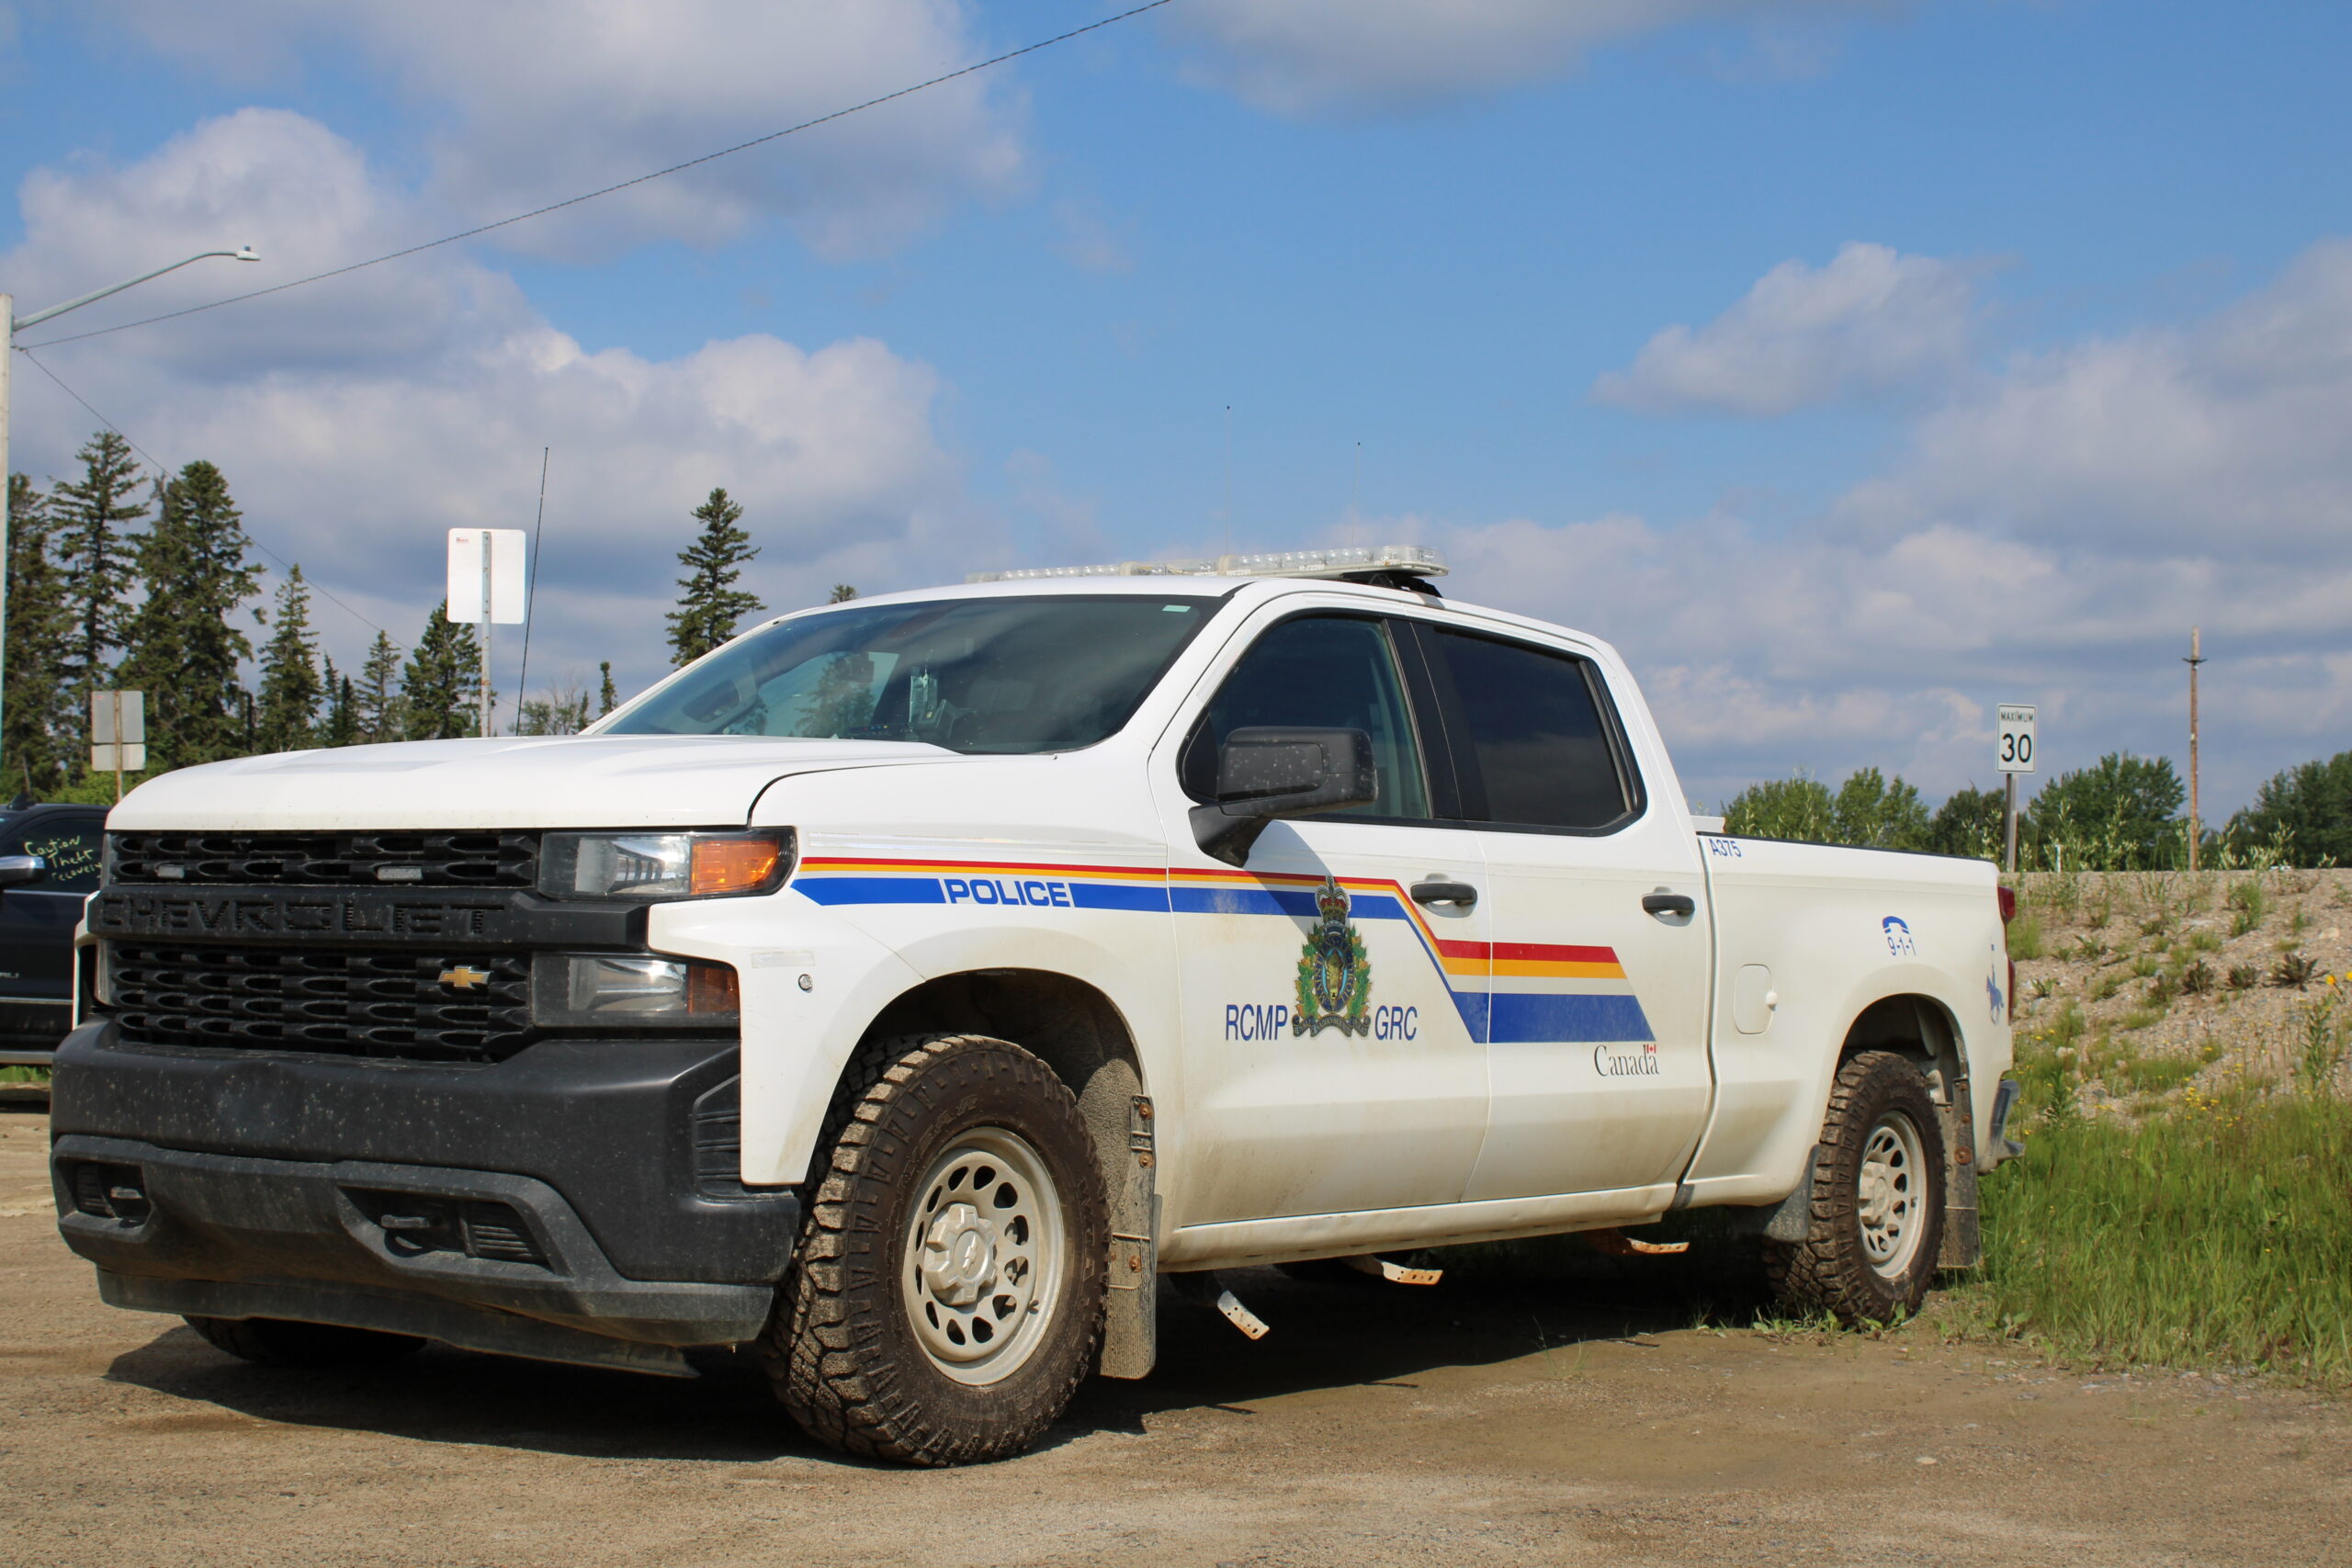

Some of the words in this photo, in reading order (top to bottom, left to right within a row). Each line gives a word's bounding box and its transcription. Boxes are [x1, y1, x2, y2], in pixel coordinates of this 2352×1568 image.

[2000, 711, 2034, 722] MAXIMUM
[2001, 733, 2032, 763] 30
[1709, 838, 1742, 858] A375
[944, 879, 1070, 908] POLICE
[100, 897, 505, 935] CHEVROLET
[1887, 936, 1917, 955] 9-1-1
[1225, 1004, 1288, 1041] RCMP
[1374, 1005, 1419, 1041] GRC
[1593, 1043, 1659, 1077] Canada
